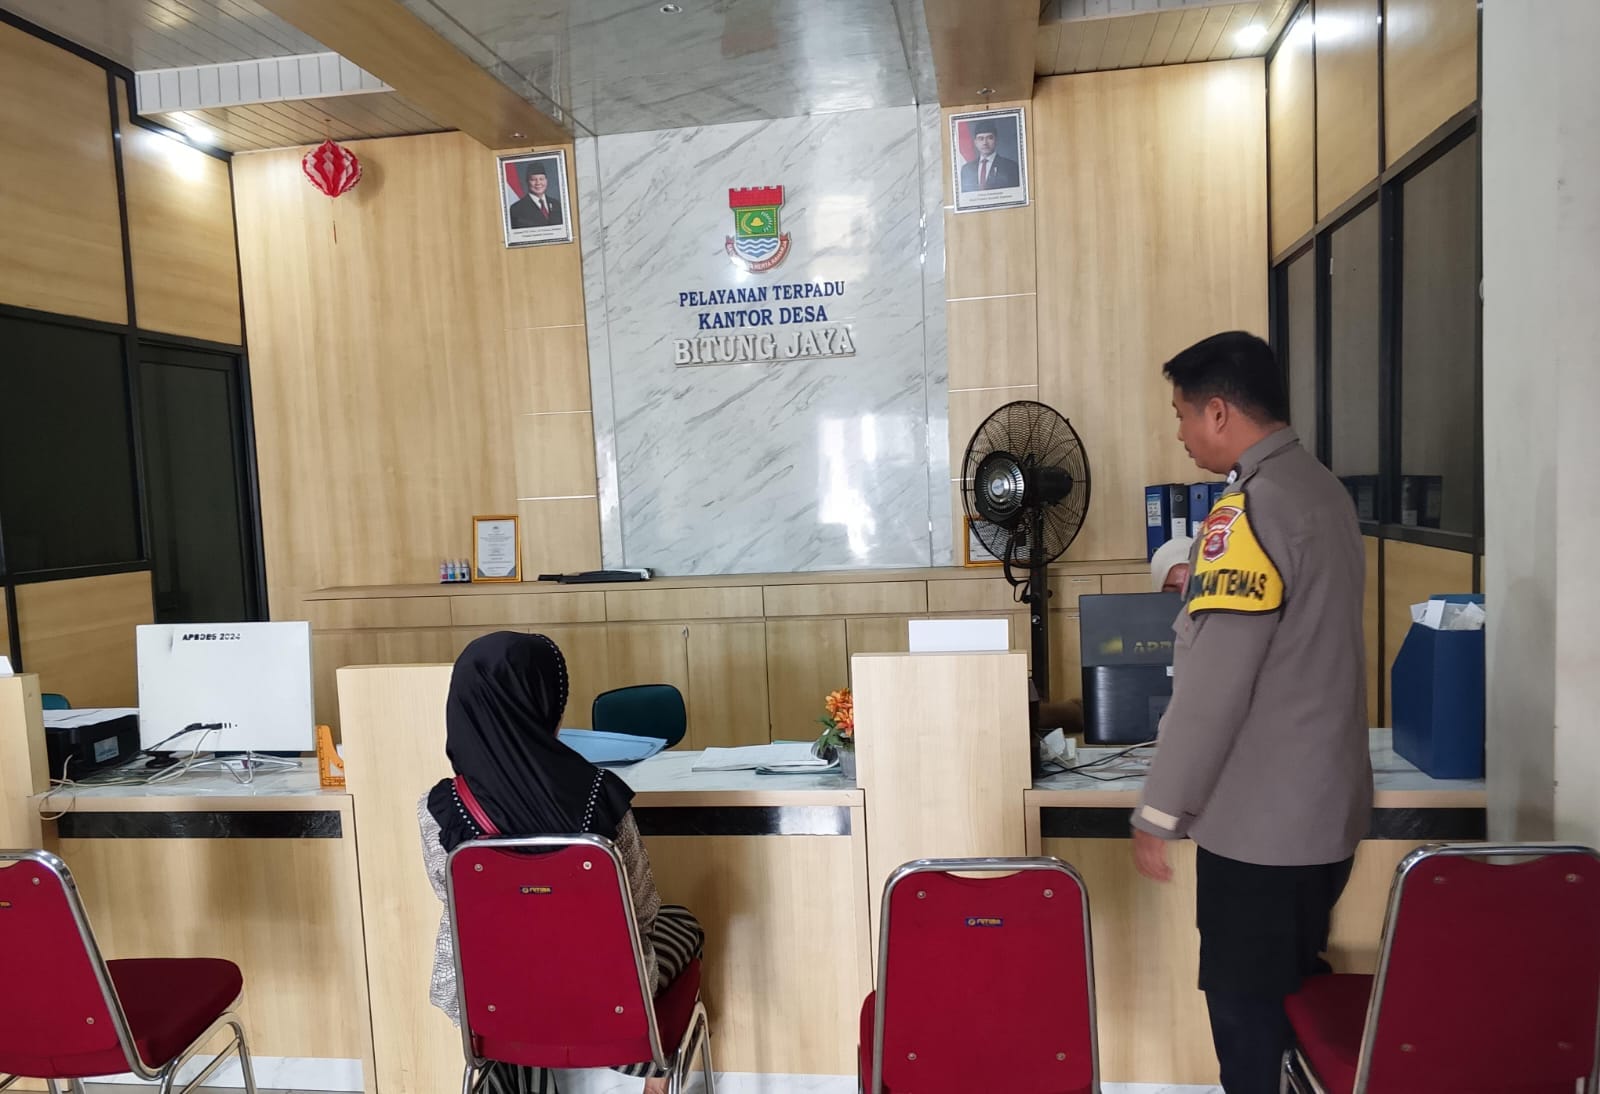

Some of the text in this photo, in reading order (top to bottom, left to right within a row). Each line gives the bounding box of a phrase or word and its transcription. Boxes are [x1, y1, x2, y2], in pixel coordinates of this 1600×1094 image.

[679, 281, 846, 307] PELAYANAN TERPADU
[698, 305, 828, 330] KANTOR DESA
[673, 327, 856, 365] BITUNG JAYA
